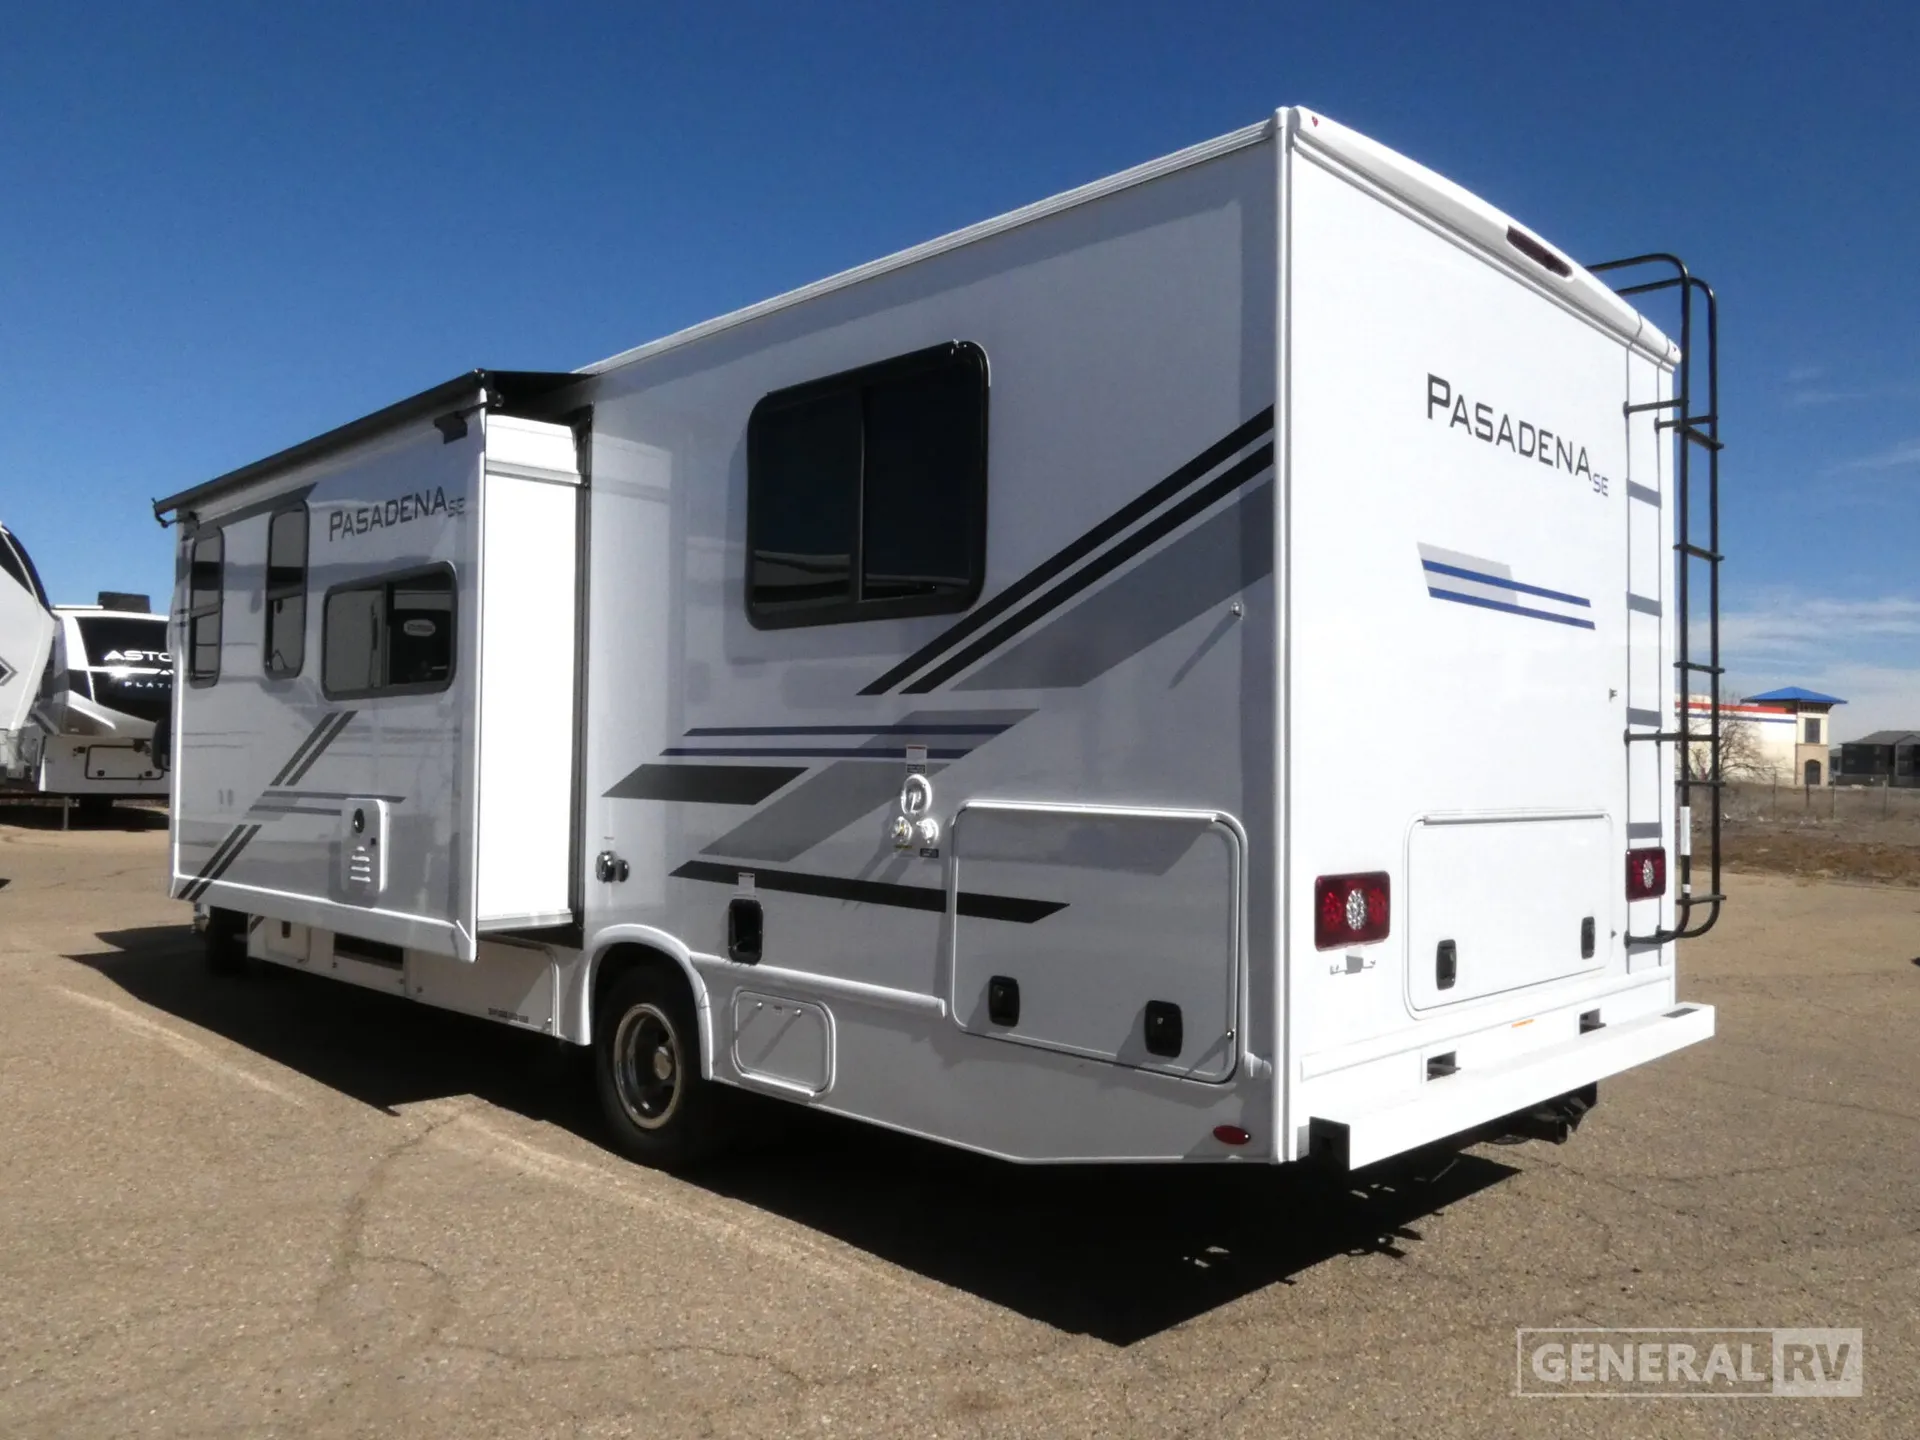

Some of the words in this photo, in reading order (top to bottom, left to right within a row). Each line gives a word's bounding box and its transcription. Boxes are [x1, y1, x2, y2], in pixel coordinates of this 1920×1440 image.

[1427, 372, 1592, 481] PASADENA
[1592, 472, 1609, 498] SE
[329, 485, 448, 542] PASADENA
[447, 497, 465, 519] SE
